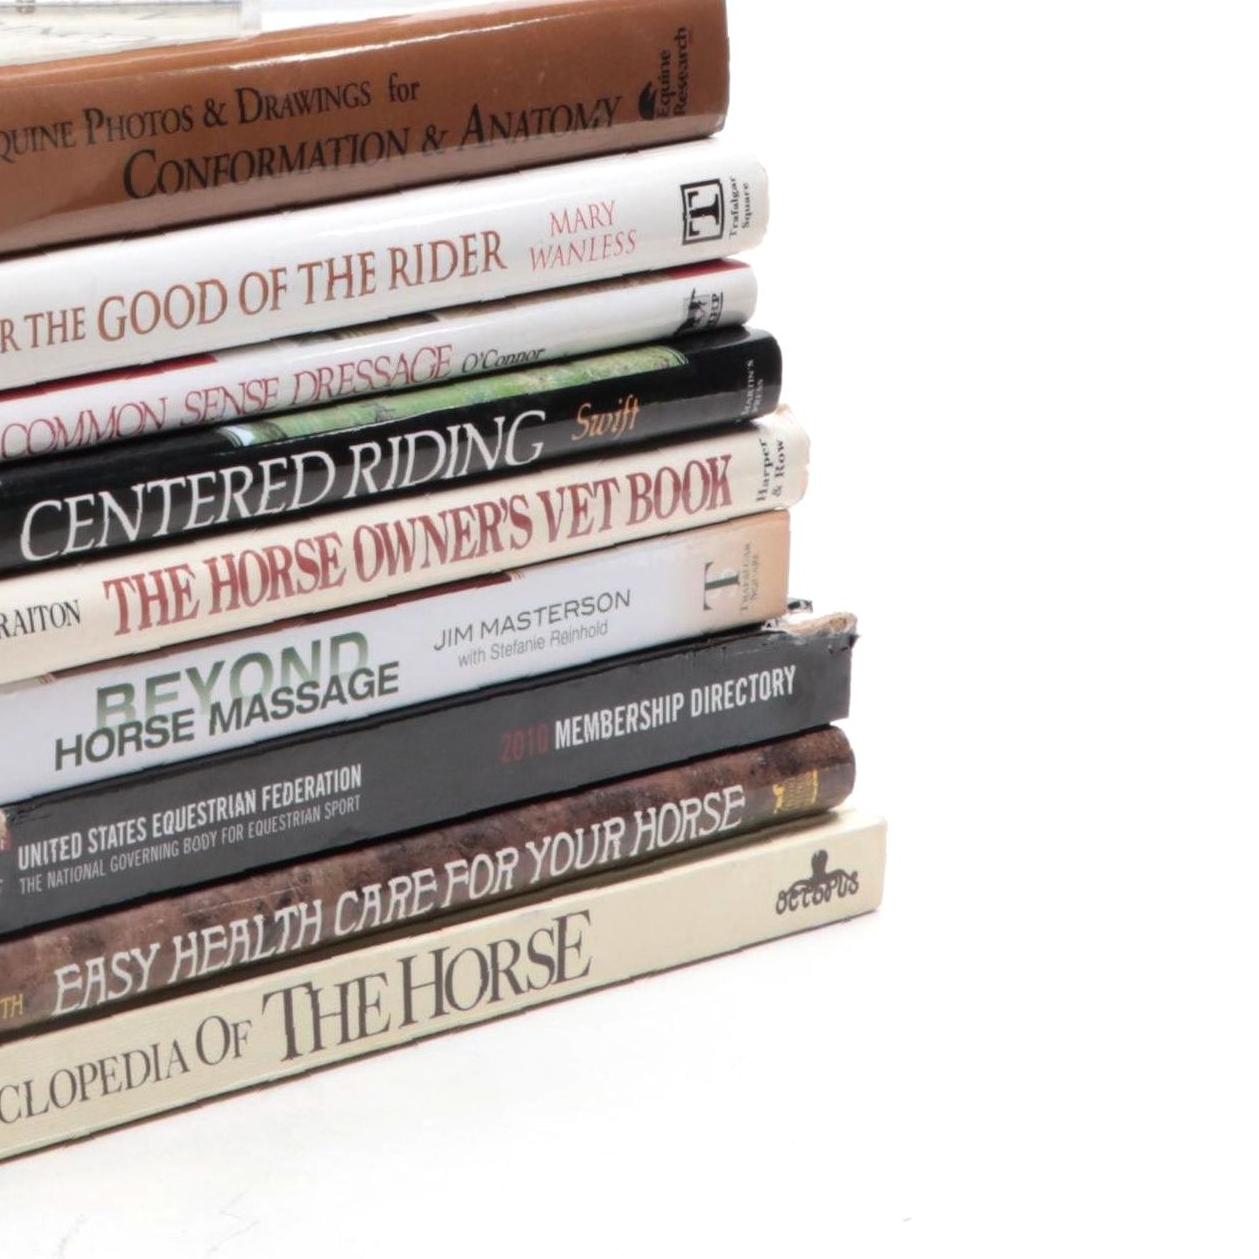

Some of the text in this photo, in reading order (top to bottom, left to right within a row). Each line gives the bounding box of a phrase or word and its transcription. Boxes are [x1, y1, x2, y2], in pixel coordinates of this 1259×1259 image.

[82, 107, 192, 145] PHOTOS
[203, 98, 228, 128] &
[235, 80, 371, 125] DRAWINGS
[388, 73, 420, 103] for
[657, 49, 672, 118] Equine
[673, 27, 689, 115] Research
[124, 96, 623, 200] CONFORMATION & ANATOMY
[549, 200, 615, 237] MARY
[729, 175, 740, 239] Trafalgar
[742, 182, 751, 229] Square
[24, 307, 86, 346] THE
[97, 278, 228, 342] GOOD
[240, 267, 288, 316] OF
[298, 251, 376, 305] THE
[388, 230, 508, 290] RIDER
[530, 229, 636, 271] WANLESS
[1, 344, 545, 461] COMMON SENSE DRESSAGE O'Connor
[20, 395, 640, 562] CENTERED RIDING Swift
[757, 439, 774, 501] Harper
[775, 440, 786, 478] Row
[103, 563, 200, 636] THE
[202, 533, 346, 617] HORSE
[353, 493, 533, 585] OWNER'S
[537, 470, 619, 537] VET
[625, 455, 733, 520] BOOK
[434, 589, 631, 652] JIM MASTERSON
[457, 620, 609, 669] with Stefanie Reinhold
[55, 661, 400, 770] HORSE MASSAGE
[96, 631, 370, 728] BEYOND
[554, 692, 685, 749] MEMBERSHIP
[691, 665, 796, 717] DIRECTORY
[18, 832, 82, 870] UNITED
[88, 817, 147, 853] STATES
[153, 788, 257, 839] EQUESTRIAN
[262, 764, 362, 813] FEDERATION
[19, 795, 361, 894] THE NATIONAL GOVERNING BODY FOR EQUESTRIAN SPORT
[51, 945, 158, 1018] EASY
[171, 904, 322, 986] HEALTH
[335, 869, 438, 935] CARE
[445, 850, 518, 907] FOR
[527, 815, 625, 886] YOUR
[634, 785, 745, 858] HORSE
[262, 972, 391, 1062] THE
[397, 909, 593, 1028] HORSE
